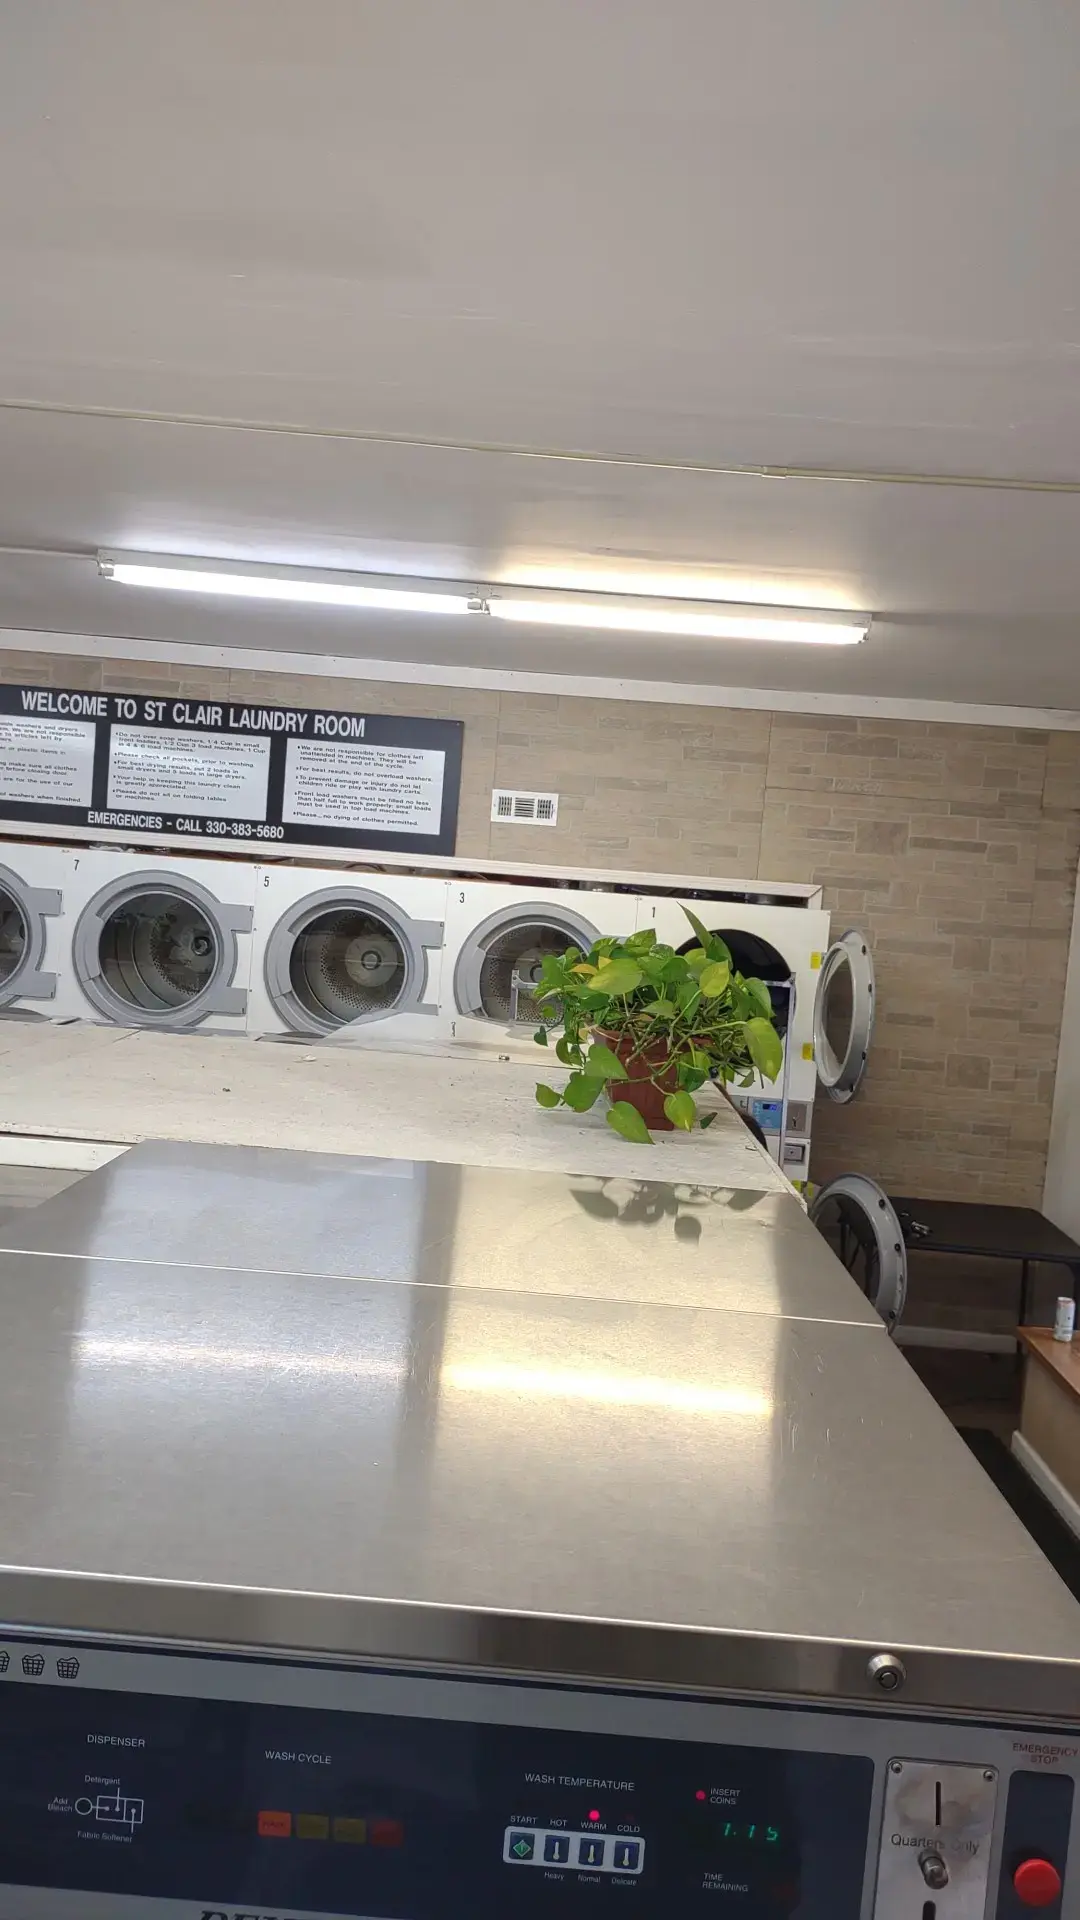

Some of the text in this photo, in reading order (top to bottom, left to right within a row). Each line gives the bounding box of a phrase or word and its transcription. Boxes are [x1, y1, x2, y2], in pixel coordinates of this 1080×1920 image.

[21, 690, 365, 738] WELCOME TO ST CLAIR LAUNDRY ROOM
[87, 810, 163, 830] EMERGENCIES
[176, 818, 202, 832] CALL
[206, 820, 285, 839] 330-383-5680
[73, 859, 80, 871] 7
[263, 876, 270, 887] 5
[459, 892, 465, 903] 3
[652, 906, 656, 918] 1
[87, 1734, 146, 1748] DISPENSER
[1012, 1742, 1079, 1757] EMERGENCY
[264, 1750, 332, 1765] WASH CYCLE
[1030, 1755, 1060, 1765] STOP
[84, 1774, 121, 1786] Detergent
[524, 1773, 635, 1791] WASH TEMPERATURE
[710, 1787, 741, 1797] INSERT
[710, 1796, 737, 1805] COINS
[510, 1815, 640, 1833] START HOT WARM COLD
[77, 1830, 100, 1840] Fabric
[891, 1833, 945, 1850] Quarters
[543, 1871, 637, 1886] Heavy Normal Delicate
[704, 1872, 724, 1882] TIME
[701, 1881, 749, 1892] REMAINING
